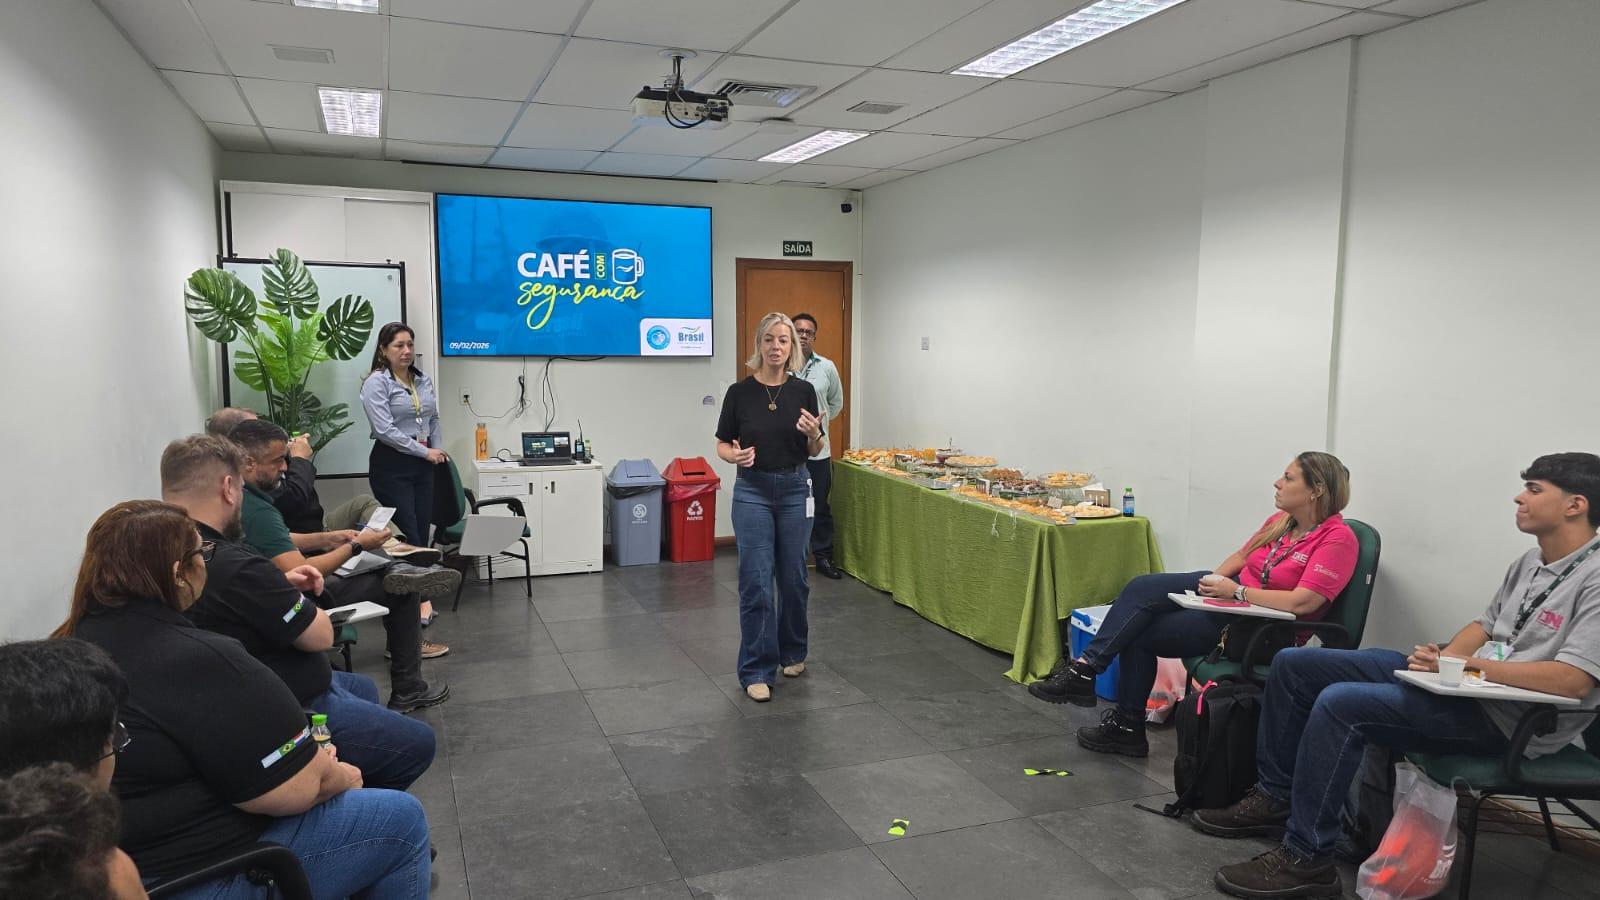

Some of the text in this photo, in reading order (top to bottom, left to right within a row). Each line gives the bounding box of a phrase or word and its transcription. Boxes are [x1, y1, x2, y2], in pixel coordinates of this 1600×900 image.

[784, 241, 812, 254] SAÍDA
[517, 249, 591, 279] CAFÉ
[596, 255, 605, 278] COM
[517, 281, 645, 330] segurança
[449, 341, 491, 350] 09/02/2026
[678, 331, 704, 342] Brasil
